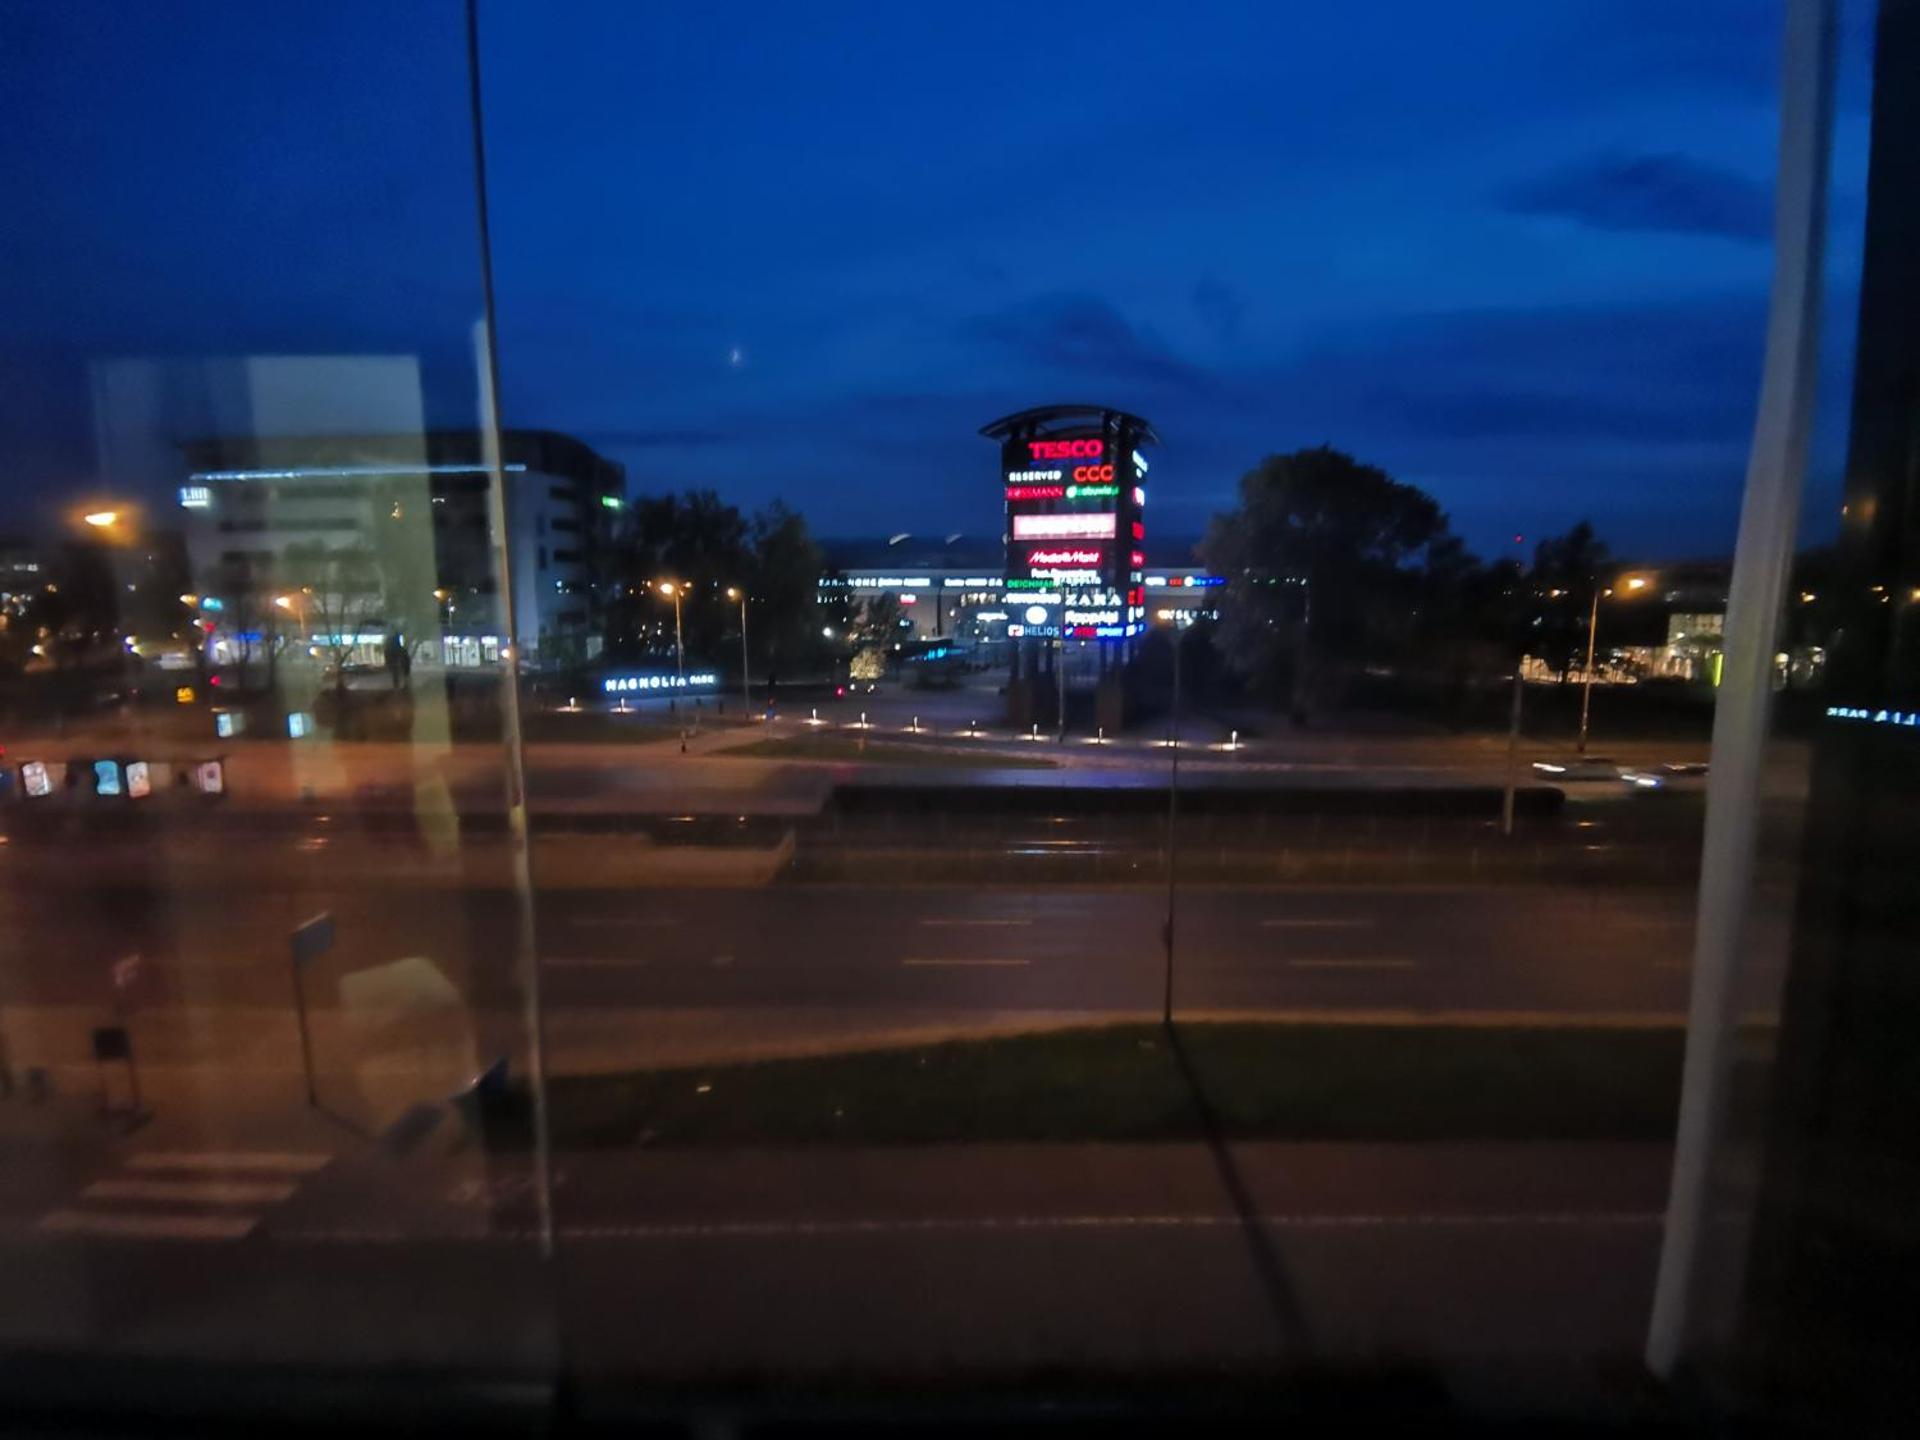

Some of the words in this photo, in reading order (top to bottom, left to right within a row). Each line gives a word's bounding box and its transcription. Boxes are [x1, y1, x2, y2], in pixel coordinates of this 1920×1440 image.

[1028, 439, 1104, 460] TESCO
[1008, 470, 1062, 482] RESERVED
[1072, 464, 1115, 483] CCC
[1064, 592, 1123, 606] ZARA
[1024, 627, 1060, 636] HELIOS
[605, 676, 686, 692] MAGNOLIA
